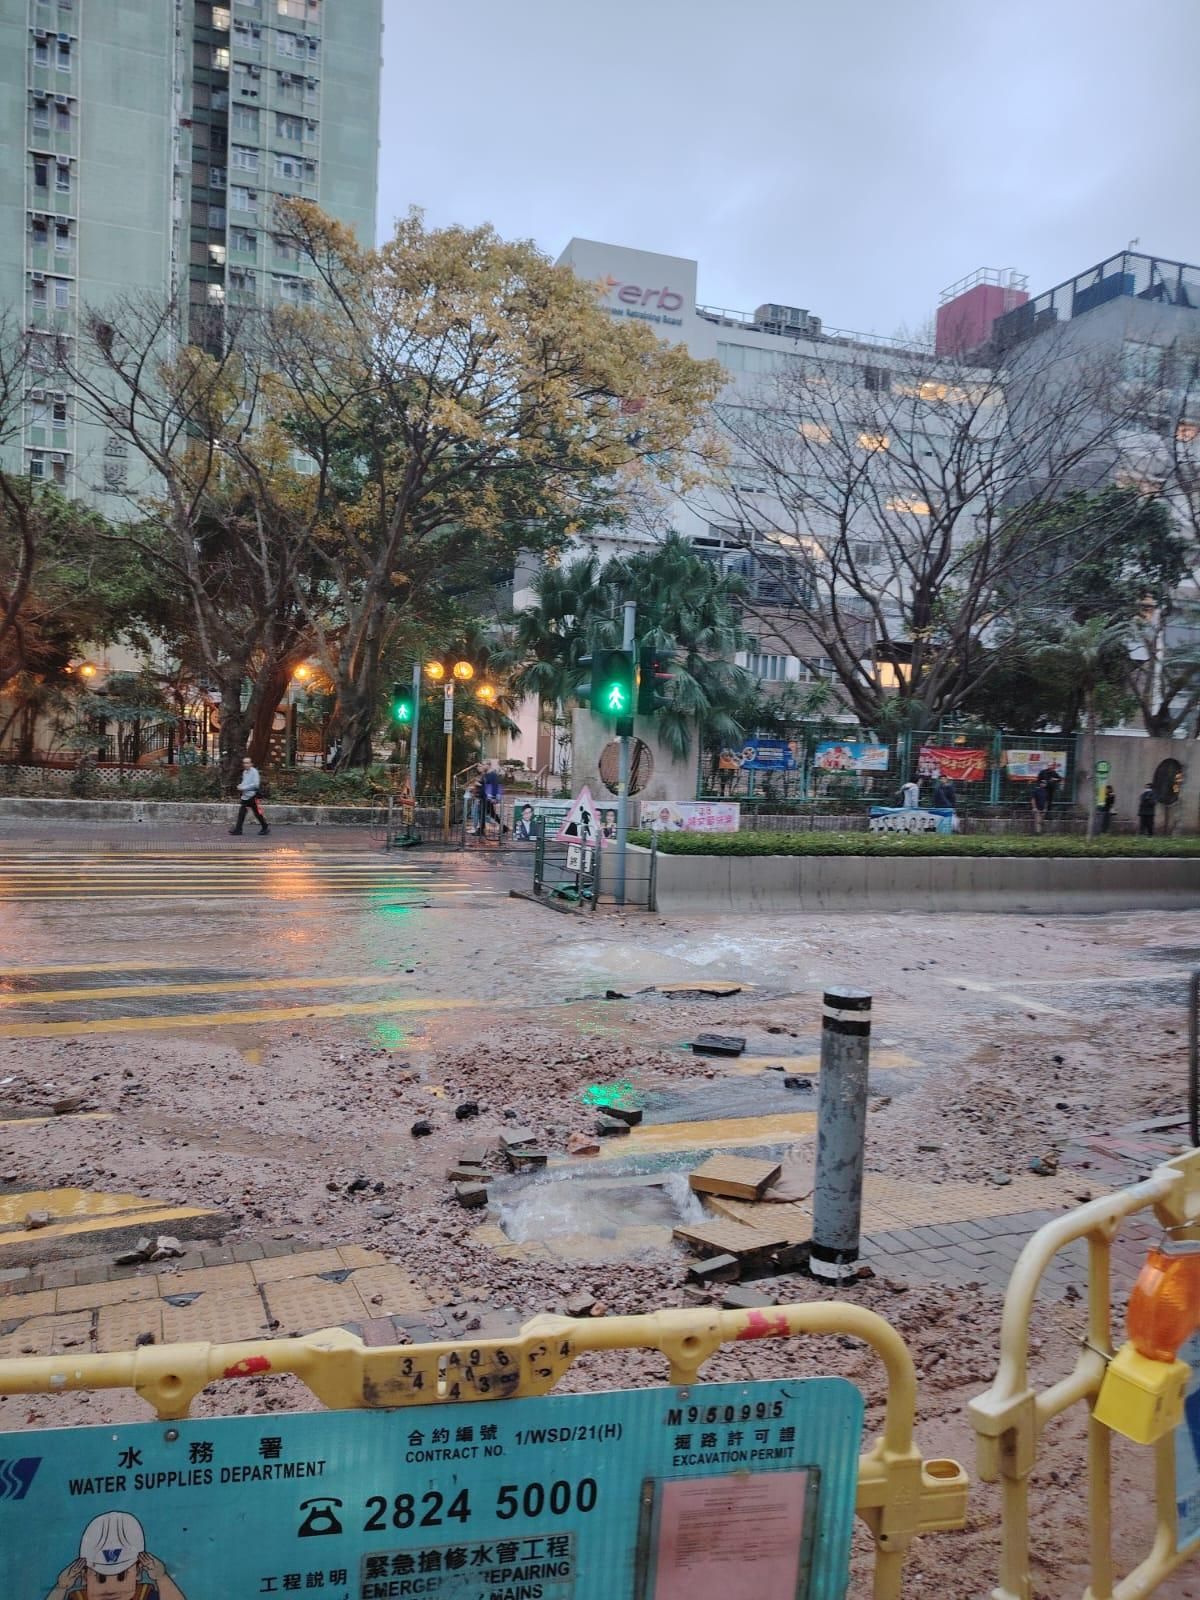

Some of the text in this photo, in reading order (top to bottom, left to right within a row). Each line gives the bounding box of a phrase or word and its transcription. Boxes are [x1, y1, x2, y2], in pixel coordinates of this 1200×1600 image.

[618, 286, 683, 311] erb
[402, 1358, 413, 1376] 3
[667, 1401, 783, 1426] M950995
[407, 1424, 498, 1447] 合約編號
[514, 1423, 623, 1446] 1/WSD/21(H)
[674, 1426, 796, 1450] 掘路許可證
[118, 1436, 283, 1470] 水務署
[405, 1444, 506, 1463] CONTRACT NO.
[673, 1447, 795, 1467] EXCAVATION PERMIT
[69, 1460, 326, 1496] WATER SUPPLIES DEPARTMENT
[363, 1478, 598, 1531] 2824 5000
[365, 1535, 570, 1580] 緊急搶修水管工程
